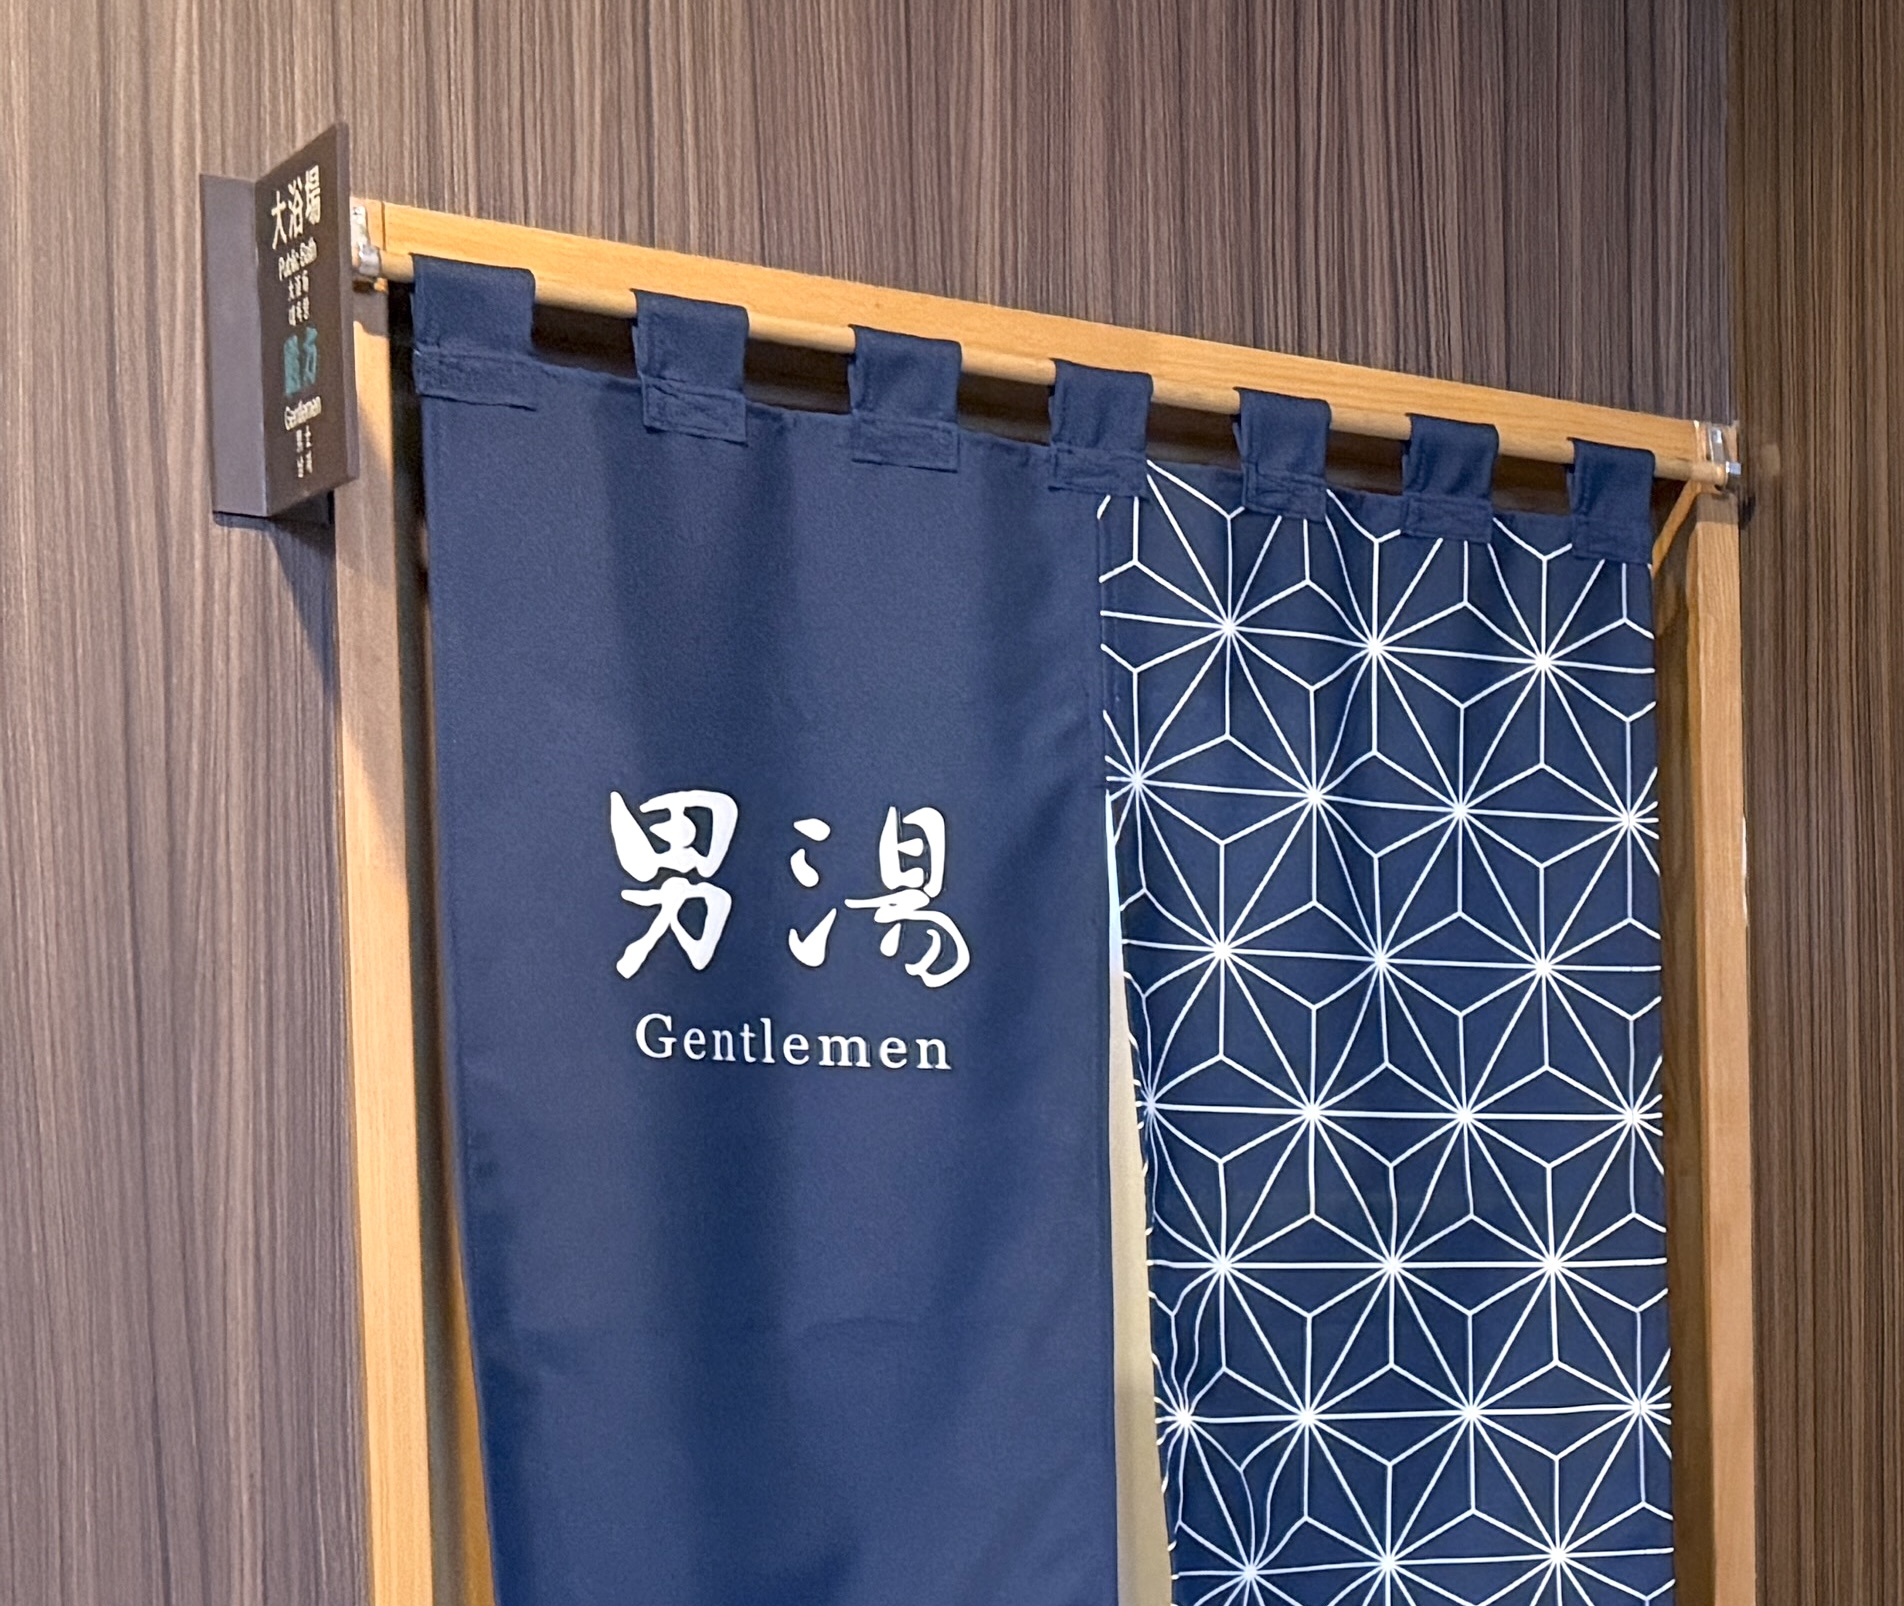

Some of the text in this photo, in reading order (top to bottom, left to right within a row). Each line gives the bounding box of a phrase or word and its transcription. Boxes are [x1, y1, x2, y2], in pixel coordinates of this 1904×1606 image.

[271, 164, 321, 250] 大浴場
[284, 396, 322, 431] Gentlemen
[610, 789, 970, 988] 男湯
[635, 1013, 952, 1070] Gentlemen
